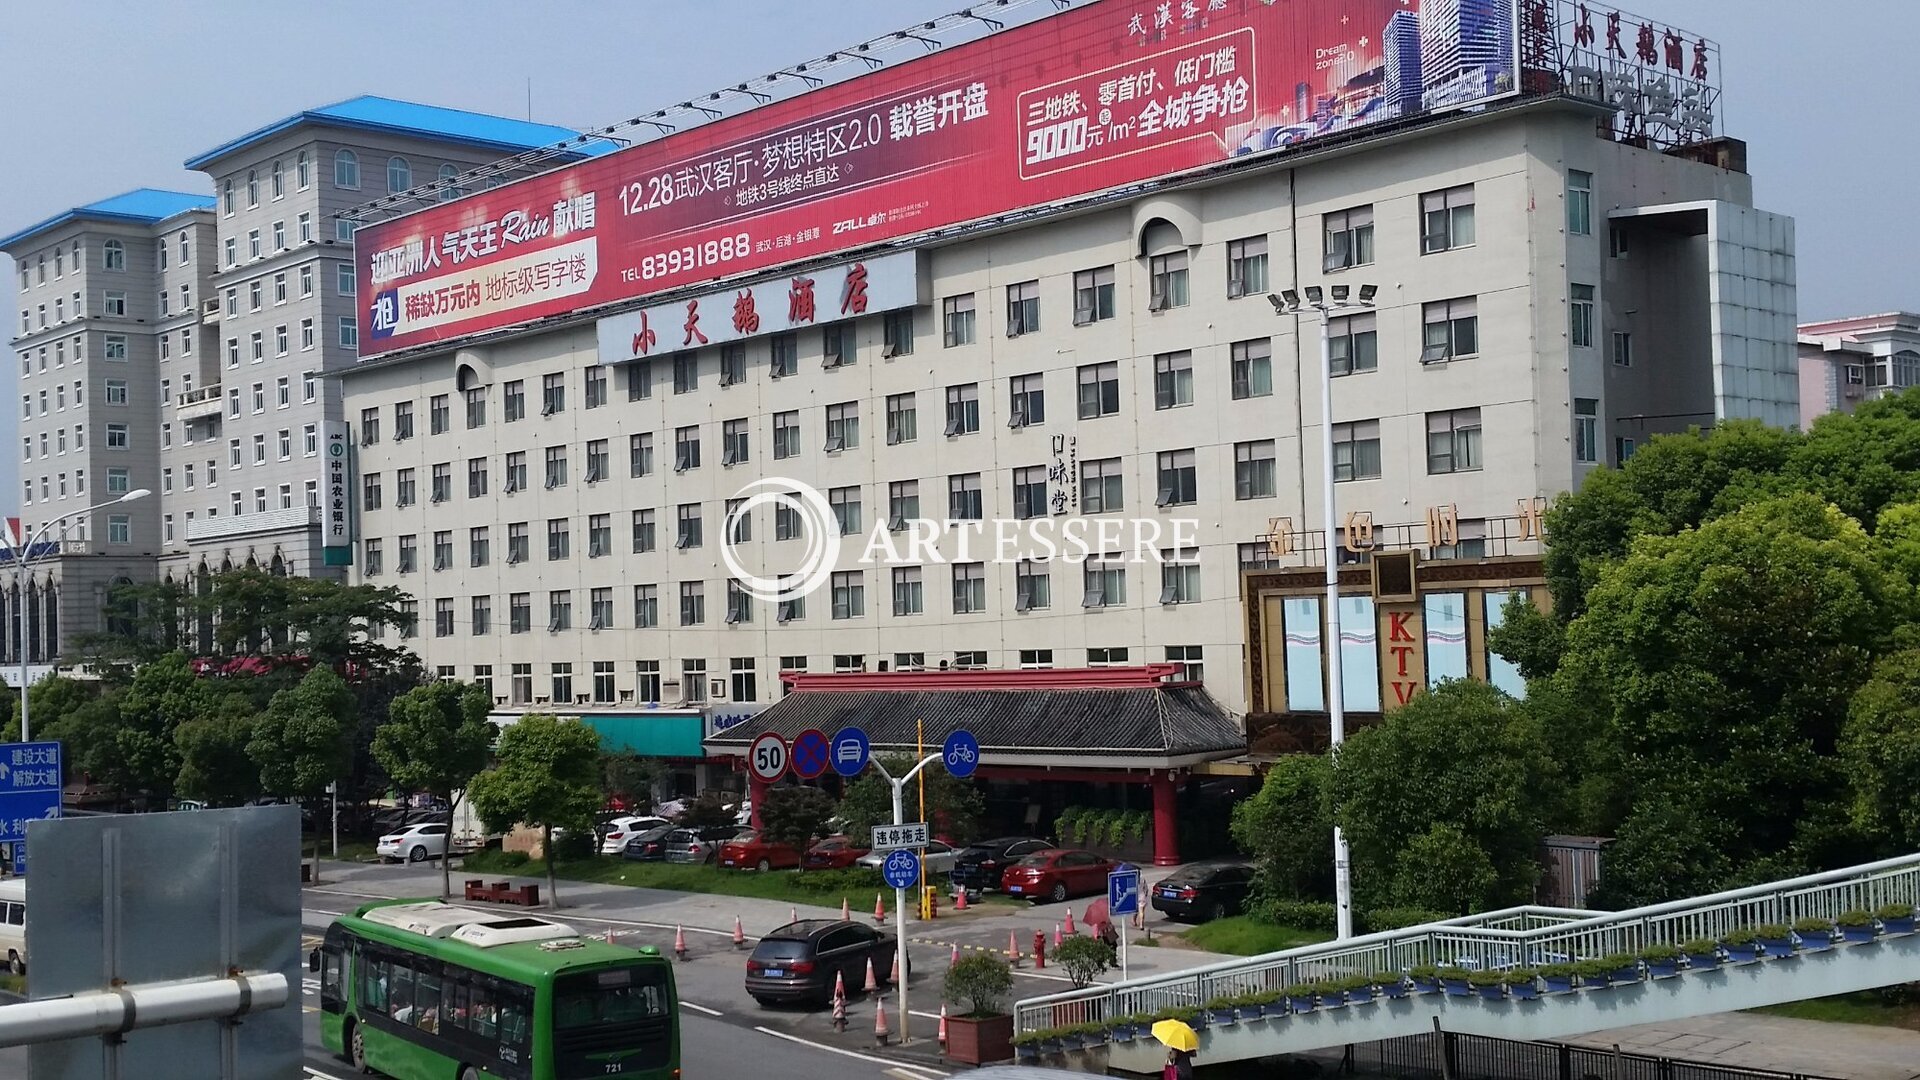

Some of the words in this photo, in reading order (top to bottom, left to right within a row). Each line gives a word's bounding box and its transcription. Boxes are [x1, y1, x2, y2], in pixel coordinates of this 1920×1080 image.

[1315, 43, 1347, 59] Dream
[1574, 3, 1708, 81] 小天鹅酒店
[889, 82, 989, 141] 载誉开盘
[370, 221, 498, 286] 迎亚洲人气天王
[500, 209, 550, 249] Rain
[552, 191, 597, 239] 献唱
[621, 268, 641, 282] TEL
[641, 232, 750, 280] 83931888
[405, 279, 481, 323] 稀缺万元内
[485, 251, 587, 302] 地标级写字楼
[632, 262, 869, 356] 小天鹅酒店
[331, 460, 344, 536] 中国农业银行
[1389, 611, 1417, 704] KTV
[11, 749, 57, 766] 建设大道
[12, 769, 57, 787] 解放大道
[758, 747, 781, 770] 50
[876, 829, 926, 845] 违停拖走
[605, 1063, 622, 1073] 721
